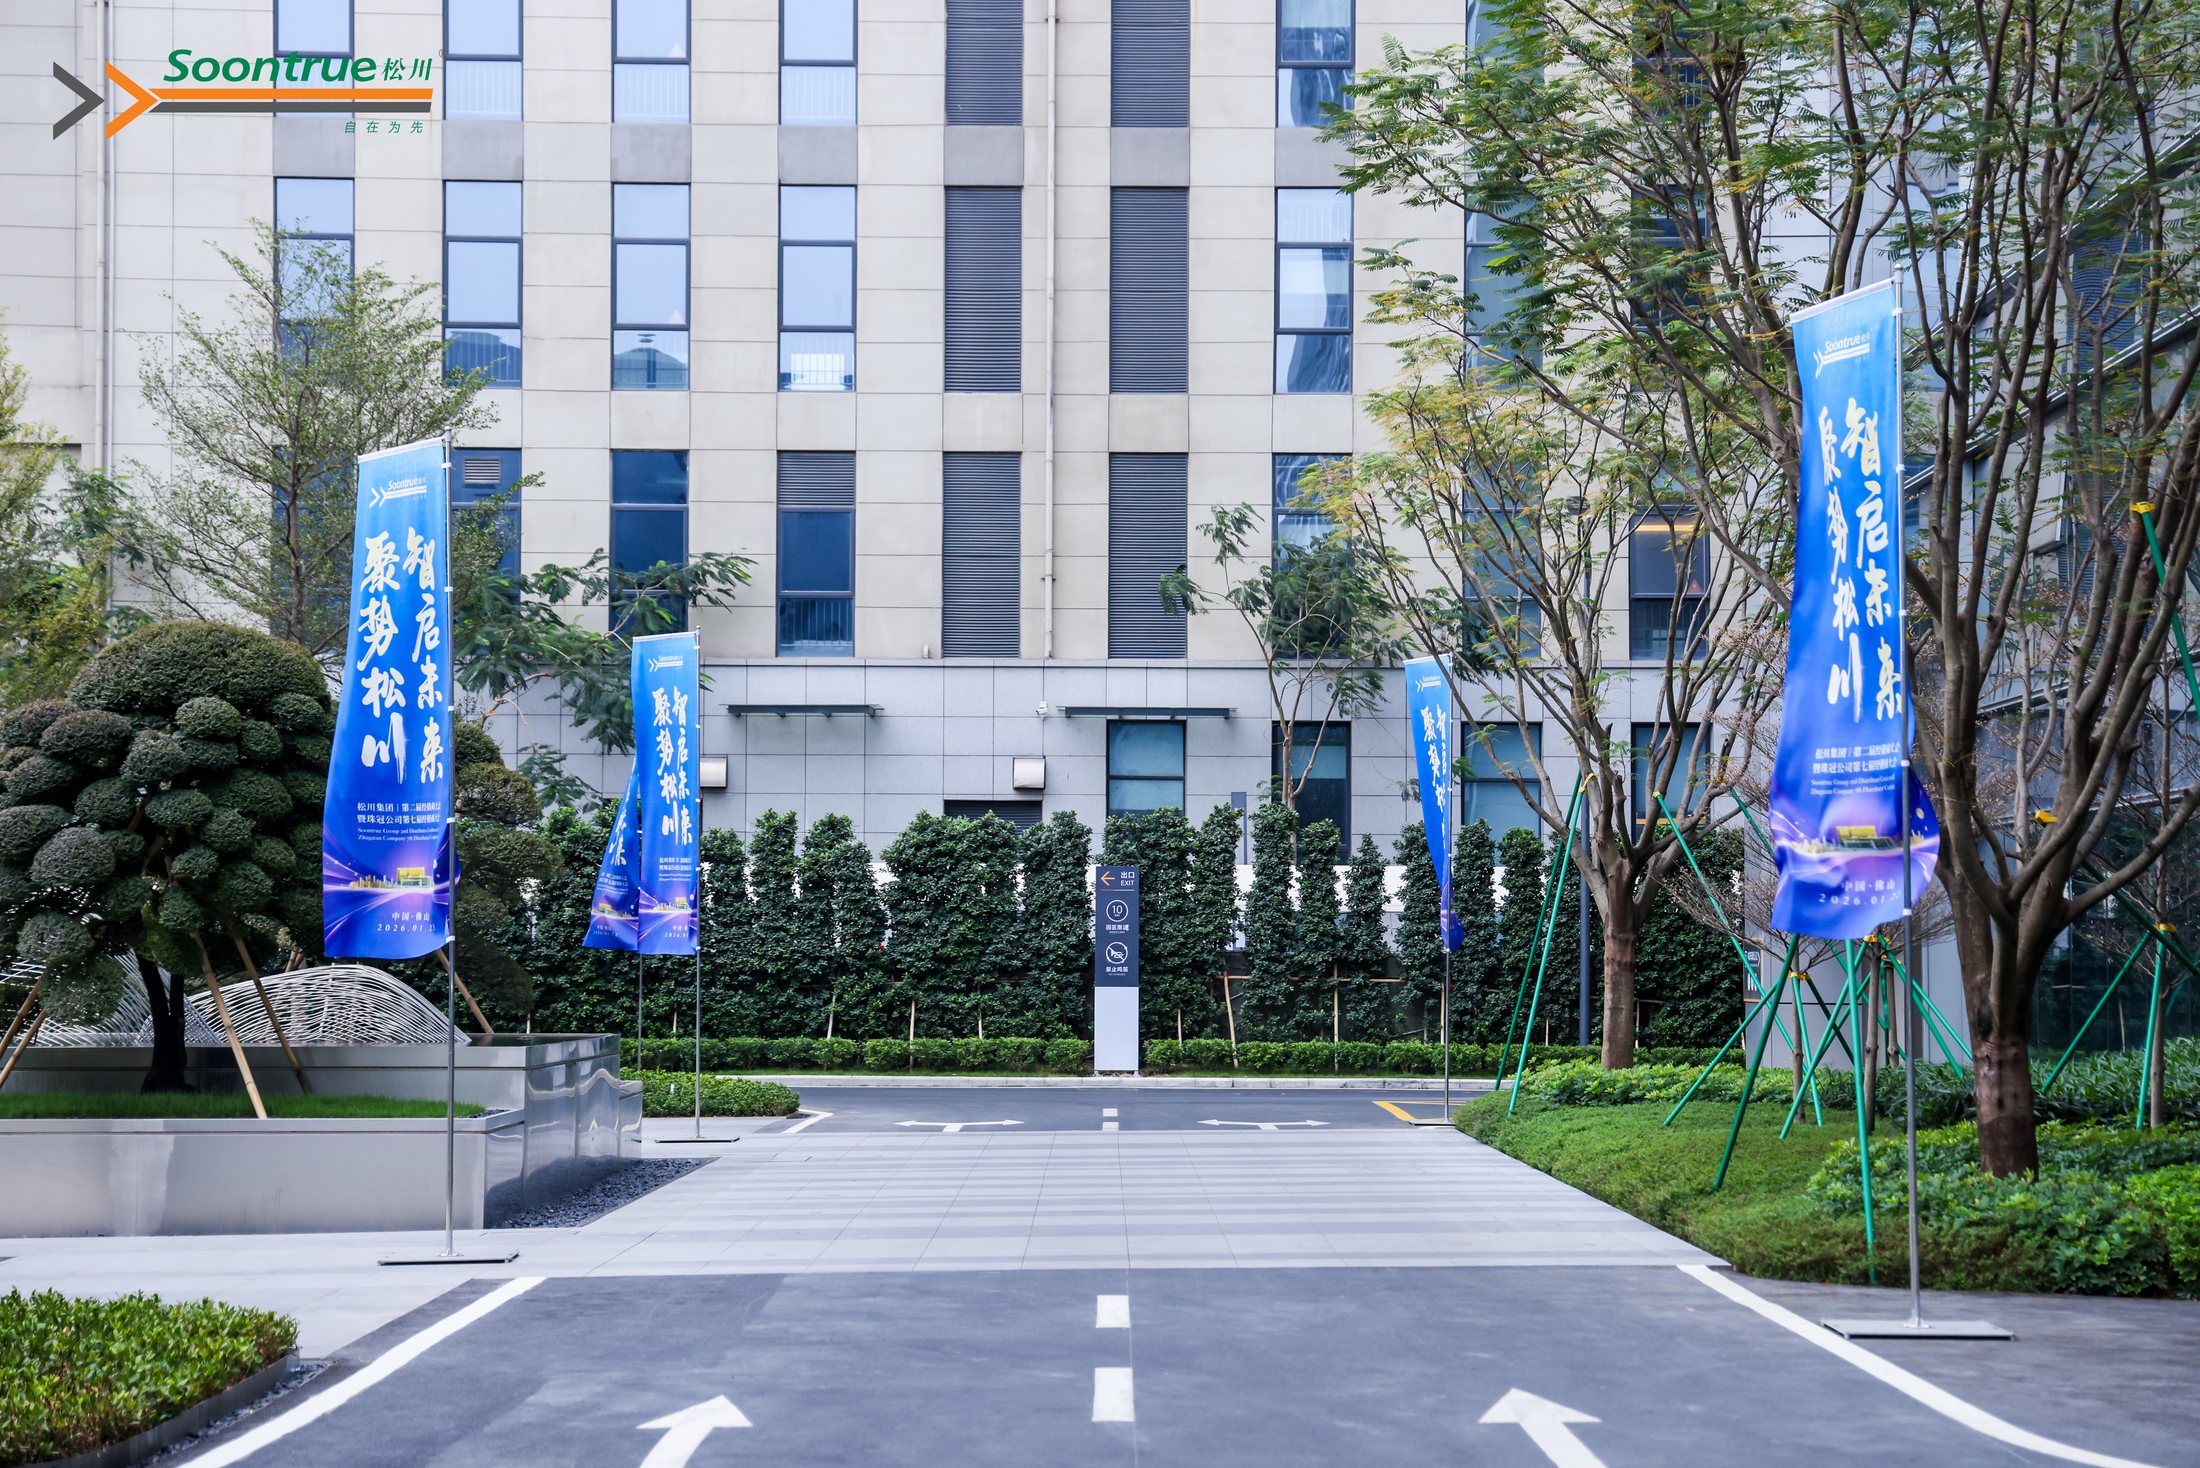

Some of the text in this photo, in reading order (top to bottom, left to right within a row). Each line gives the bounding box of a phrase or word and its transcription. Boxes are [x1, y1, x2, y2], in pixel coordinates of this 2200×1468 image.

[1824, 335, 1861, 354] Soontrue
[388, 477, 418, 491] Soontrue
[356, 530, 407, 784] 聚势松川
[357, 802, 394, 812] 松川集团
[1120, 871, 1135, 879] 出口
[1112, 905, 1123, 914] 10
